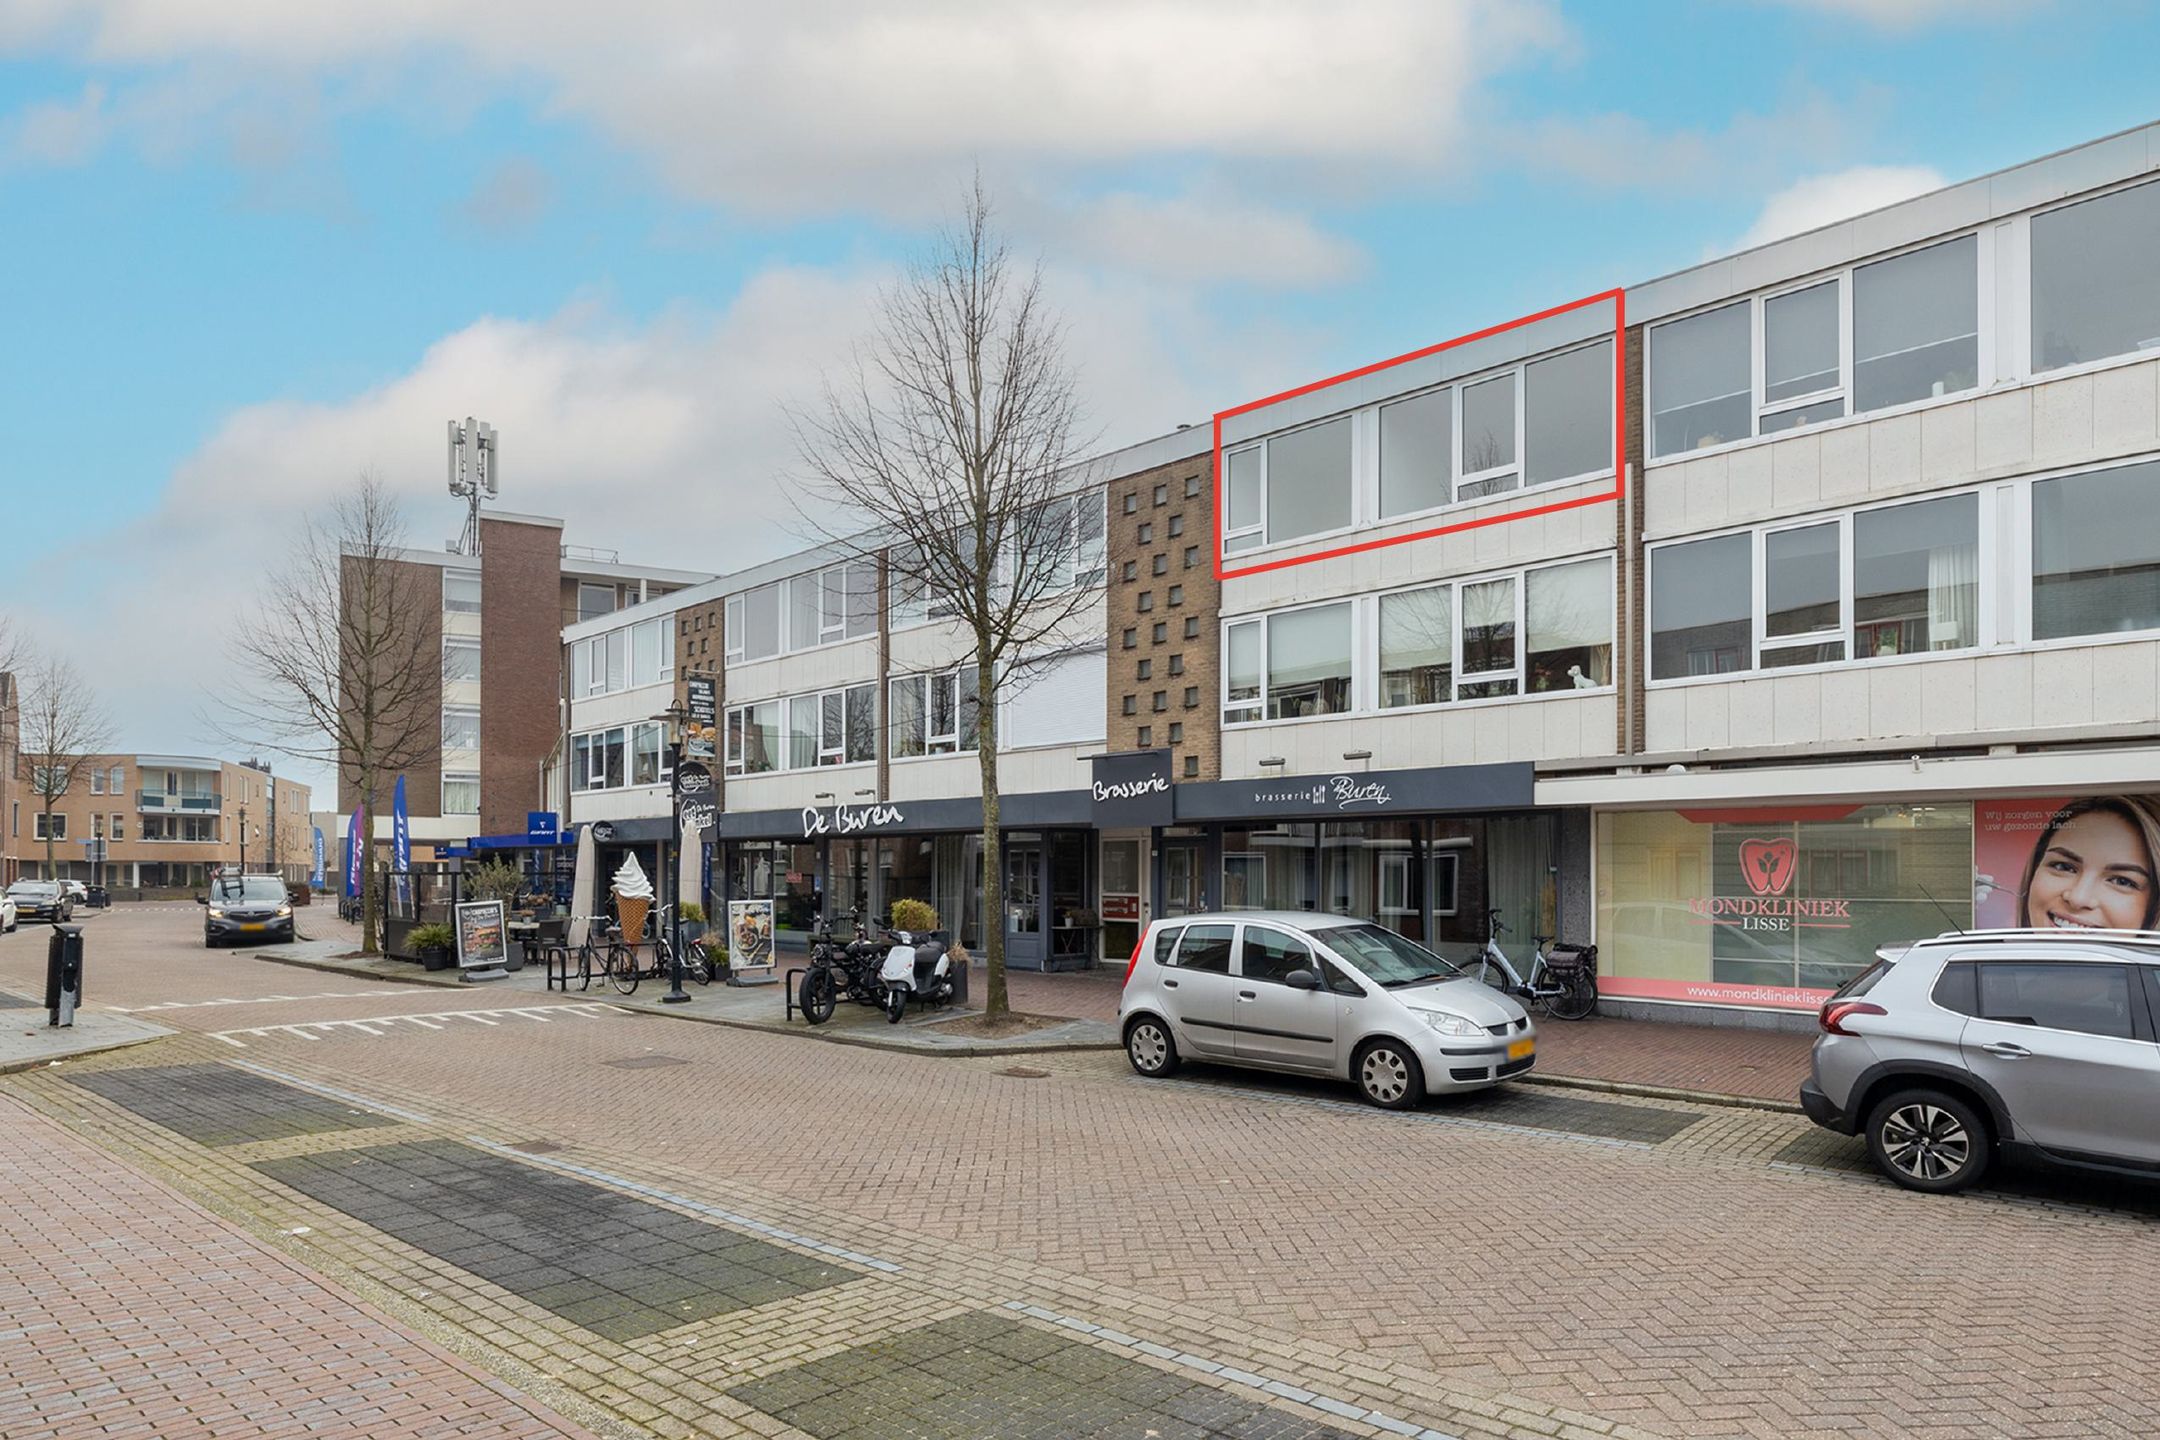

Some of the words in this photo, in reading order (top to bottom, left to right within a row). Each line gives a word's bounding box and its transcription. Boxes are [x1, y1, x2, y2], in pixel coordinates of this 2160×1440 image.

[1092, 772, 1170, 802] Brasserie
[1255, 791, 1311, 803] brasserie
[802, 806, 829, 839] De
[835, 802, 904, 833] Buren
[2005, 811, 2043, 820] zorgen
[2046, 810, 2073, 818] voor
[1688, 898, 1851, 917] MONDKLINIEK
[1743, 917, 1791, 932] LISSE
